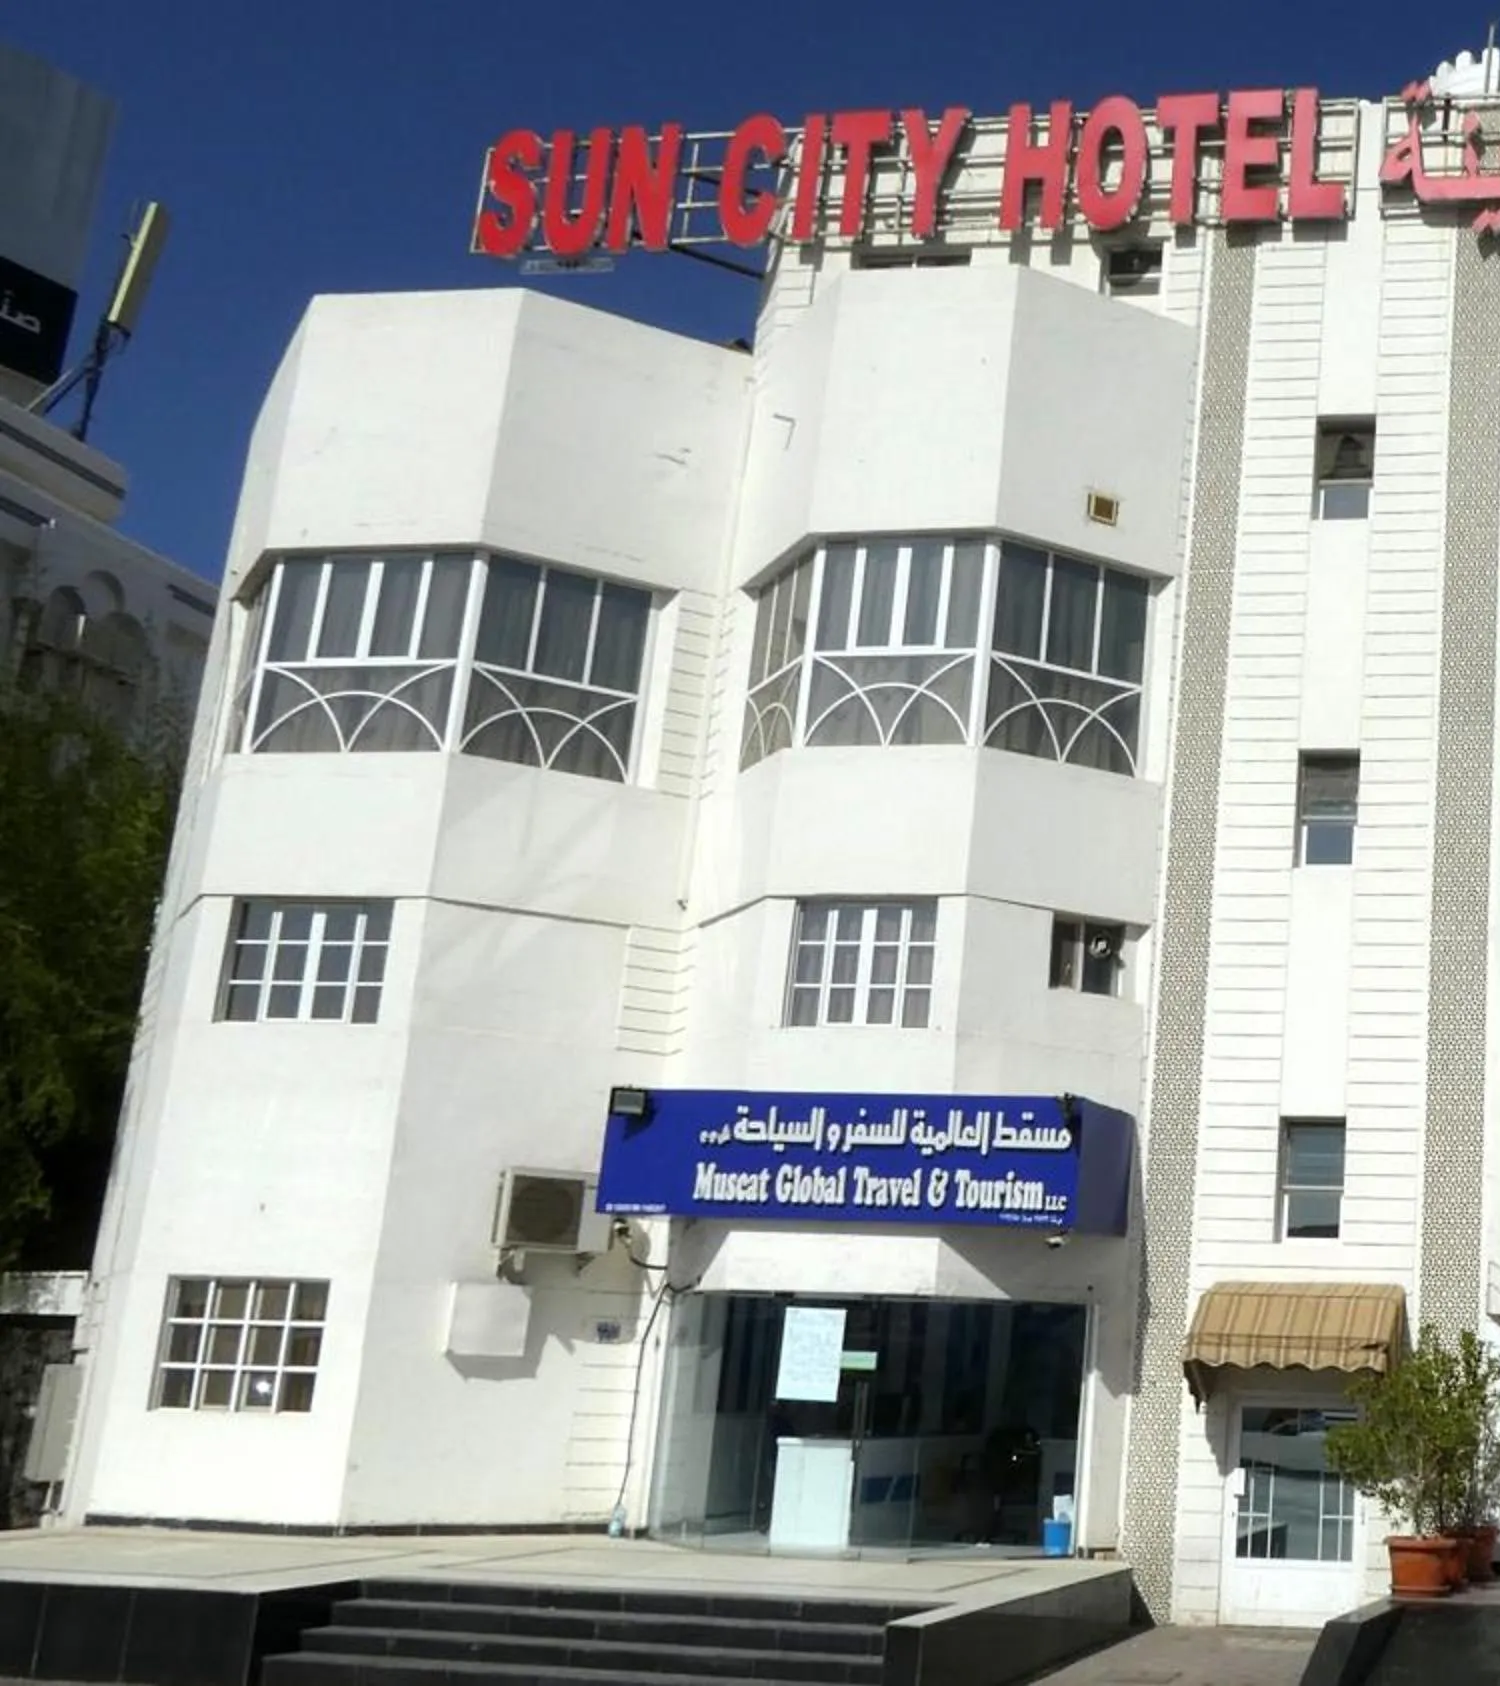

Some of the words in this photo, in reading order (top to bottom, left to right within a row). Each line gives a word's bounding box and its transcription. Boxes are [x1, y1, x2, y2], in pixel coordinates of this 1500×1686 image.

[477, 126, 682, 259] SUN
[718, 106, 968, 248] CITY
[999, 87, 1348, 234] HOTEL
[842, 1107, 908, 1152] للسفر
[910, 1109, 990, 1156] العالمية
[992, 1111, 1072, 1149] مسقط
[692, 1161, 771, 1202] Muscat
[775, 1163, 847, 1204] Global
[853, 1165, 922, 1207] Travel
[927, 1167, 949, 1207] &
[954, 1168, 1044, 1210] Tourism
[1044, 1195, 1067, 1211] LLC
